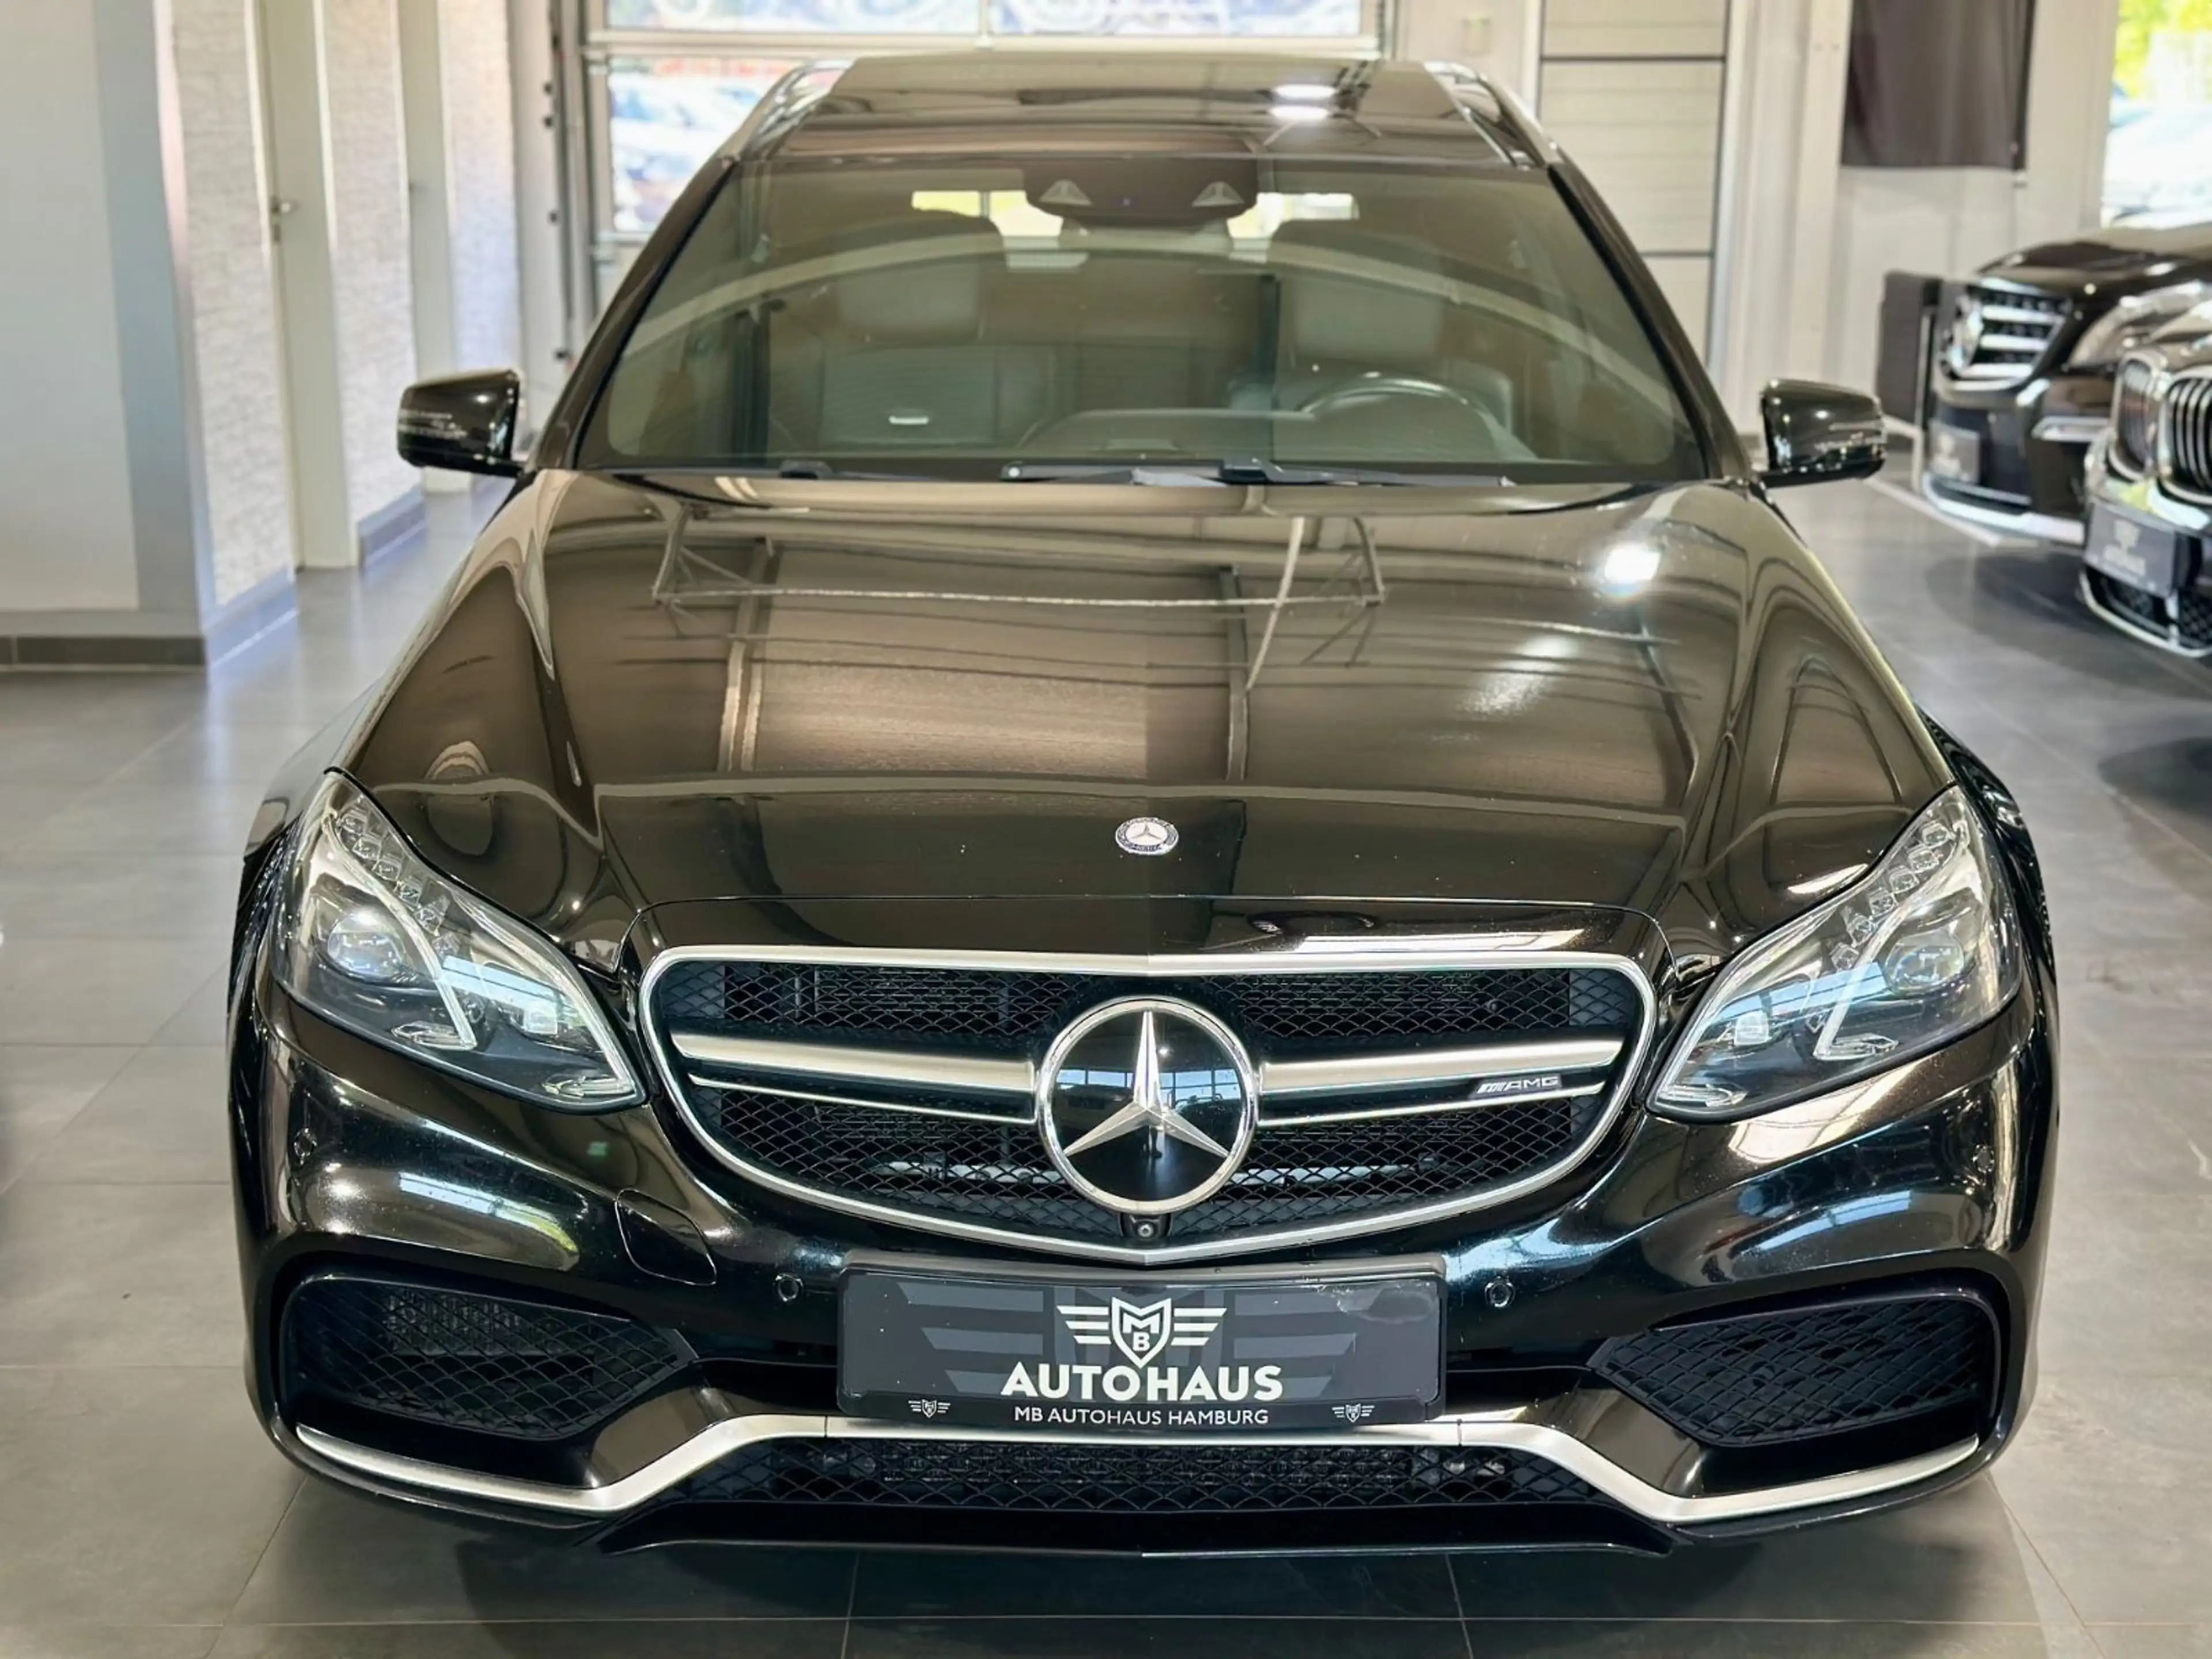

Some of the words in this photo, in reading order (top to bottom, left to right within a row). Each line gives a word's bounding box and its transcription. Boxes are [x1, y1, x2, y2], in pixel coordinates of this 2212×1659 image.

[1000, 1361, 1284, 1402] AUTOHAUS
[1014, 1406, 1043, 1422] MB
[1047, 1407, 1162, 1426] AUTOHAUS
[1168, 1408, 1270, 1426] HAMBURG
